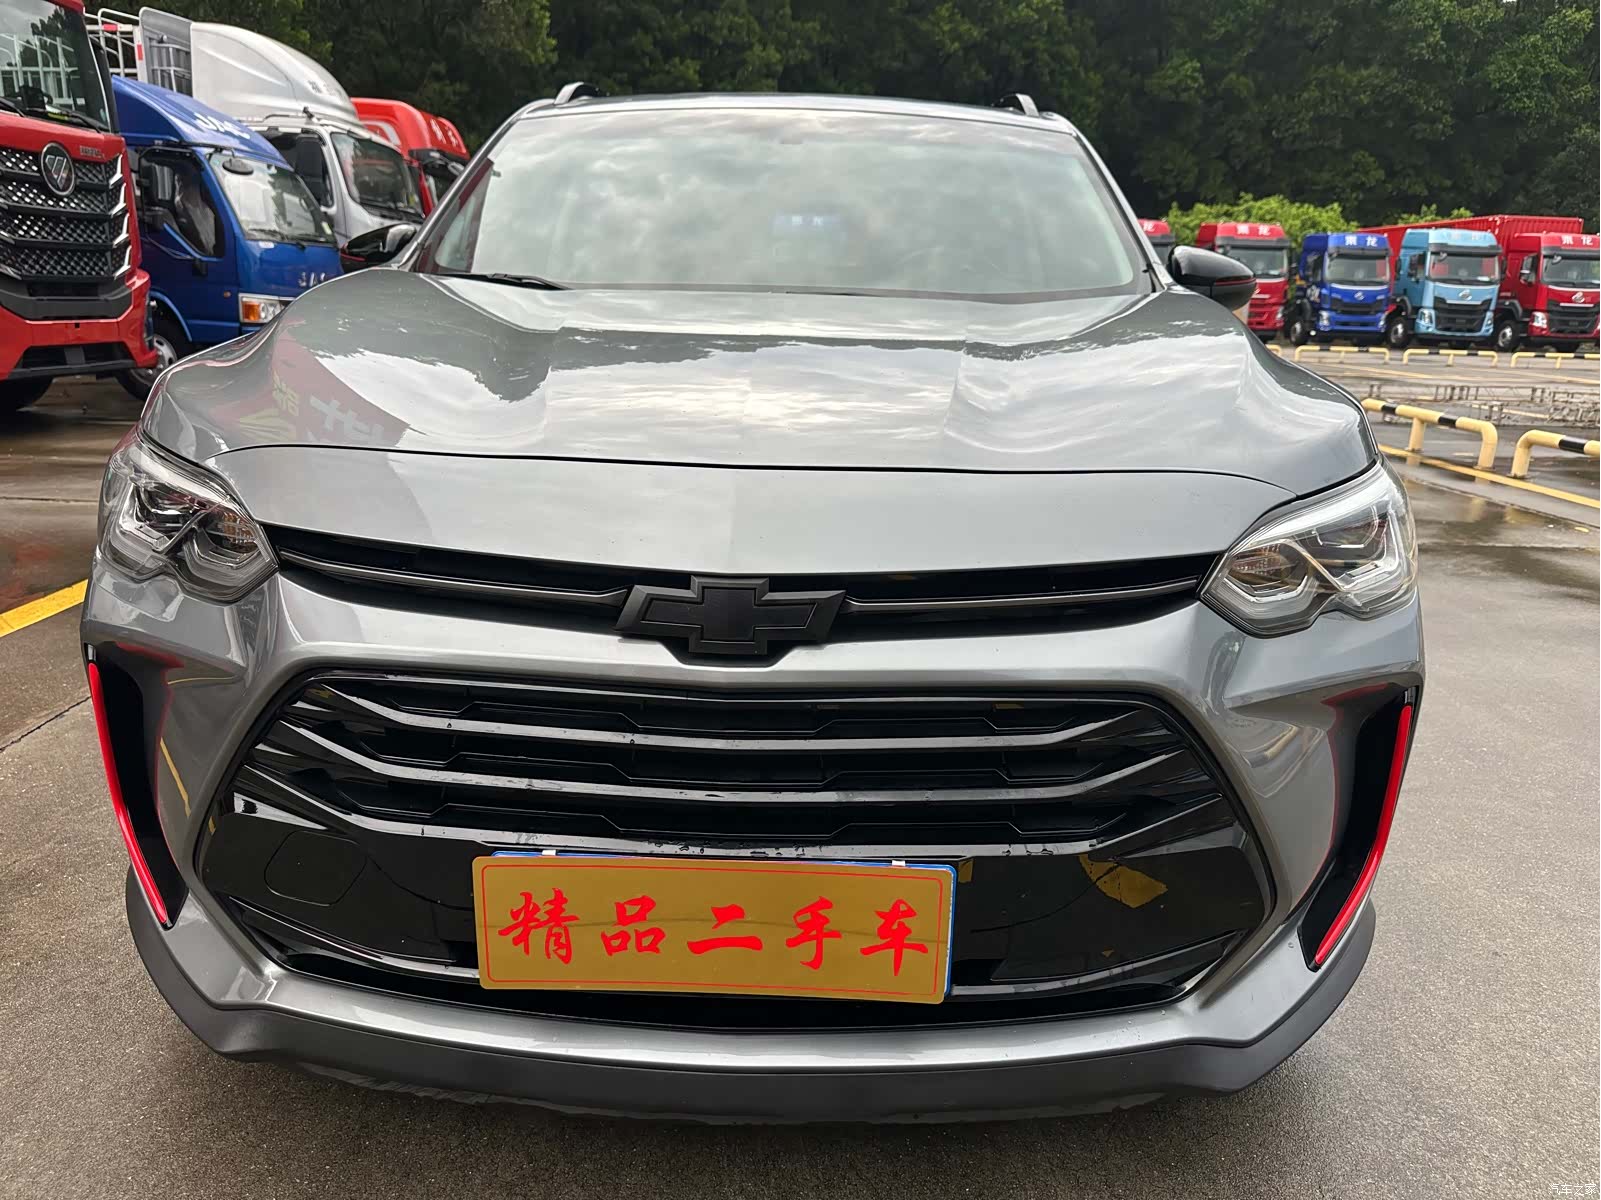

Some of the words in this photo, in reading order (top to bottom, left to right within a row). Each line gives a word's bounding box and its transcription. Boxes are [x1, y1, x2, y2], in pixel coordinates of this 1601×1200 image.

[498, 887, 928, 976] 精品二手车
